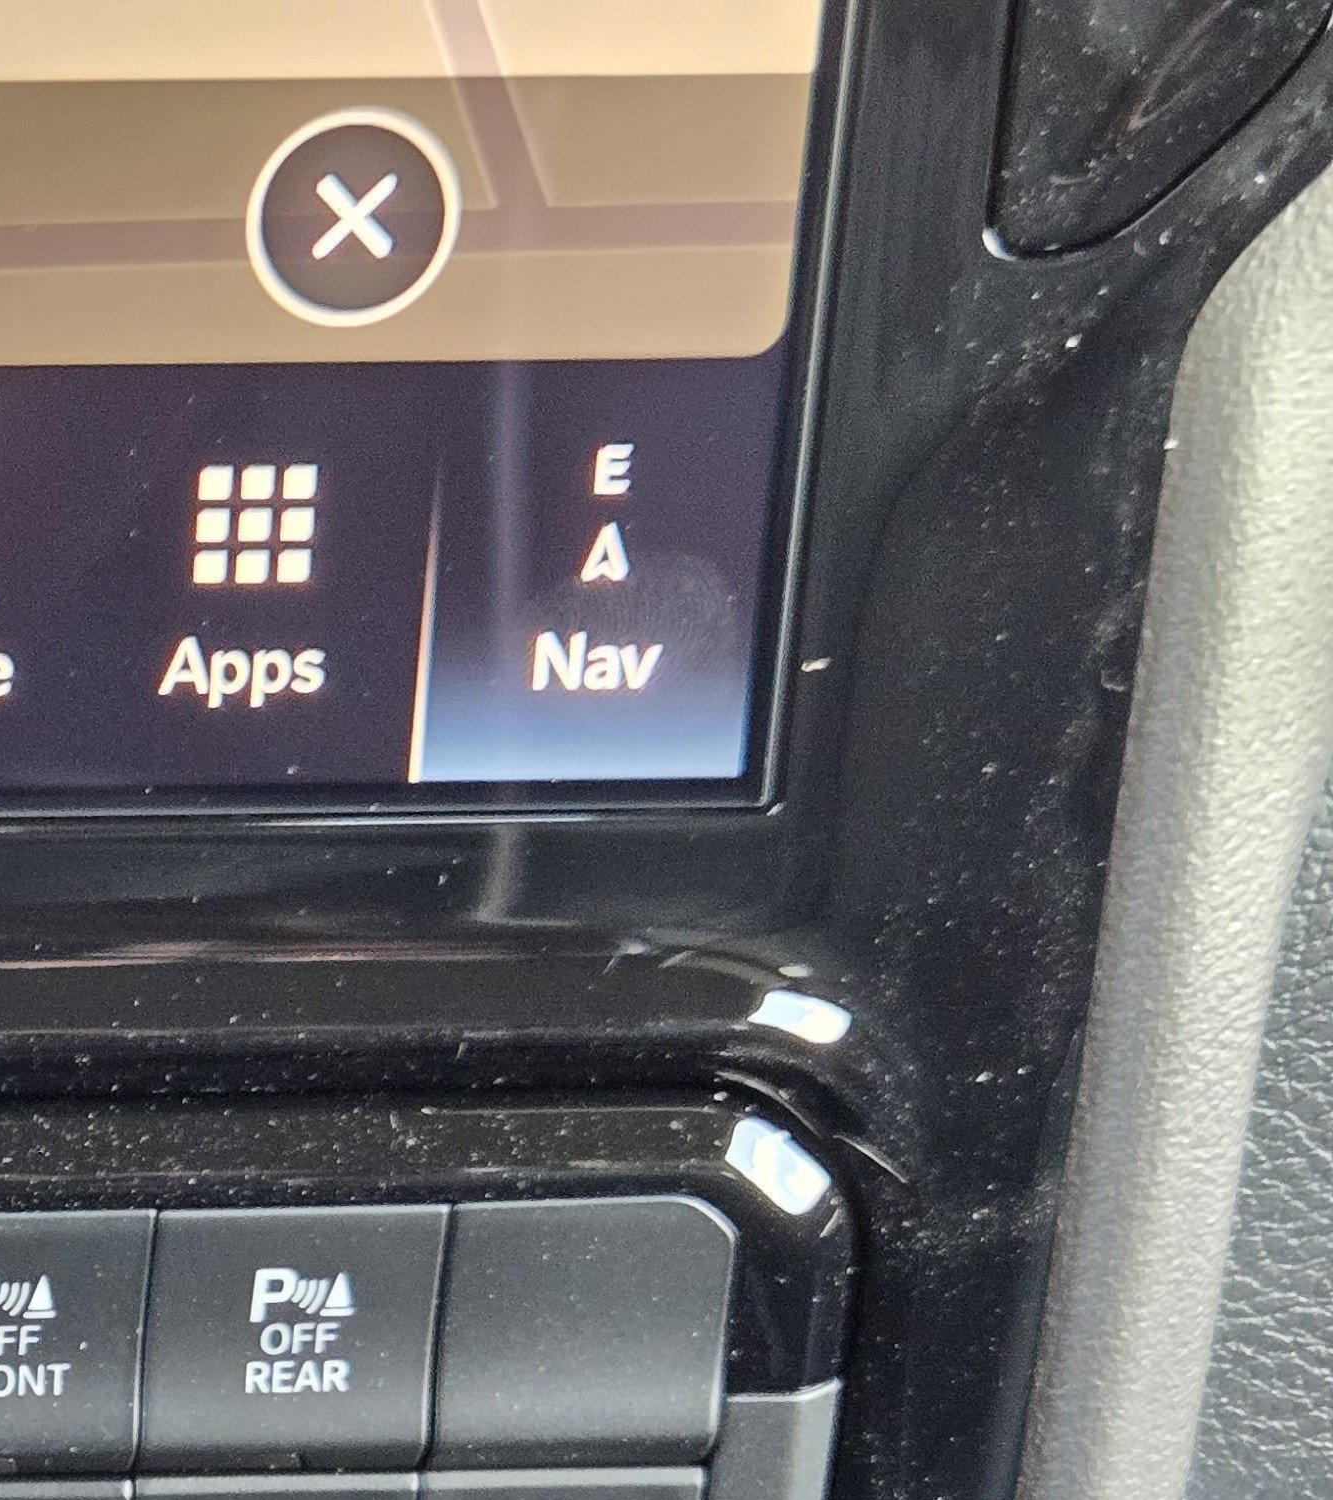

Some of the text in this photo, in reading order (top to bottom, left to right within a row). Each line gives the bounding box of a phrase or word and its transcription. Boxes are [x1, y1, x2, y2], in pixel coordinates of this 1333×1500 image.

[593, 443, 634, 496] E
[157, 636, 326, 709] Apps
[531, 631, 663, 691] Nav
[260, 1321, 340, 1356] OFF
[244, 1359, 350, 1394] REAR
